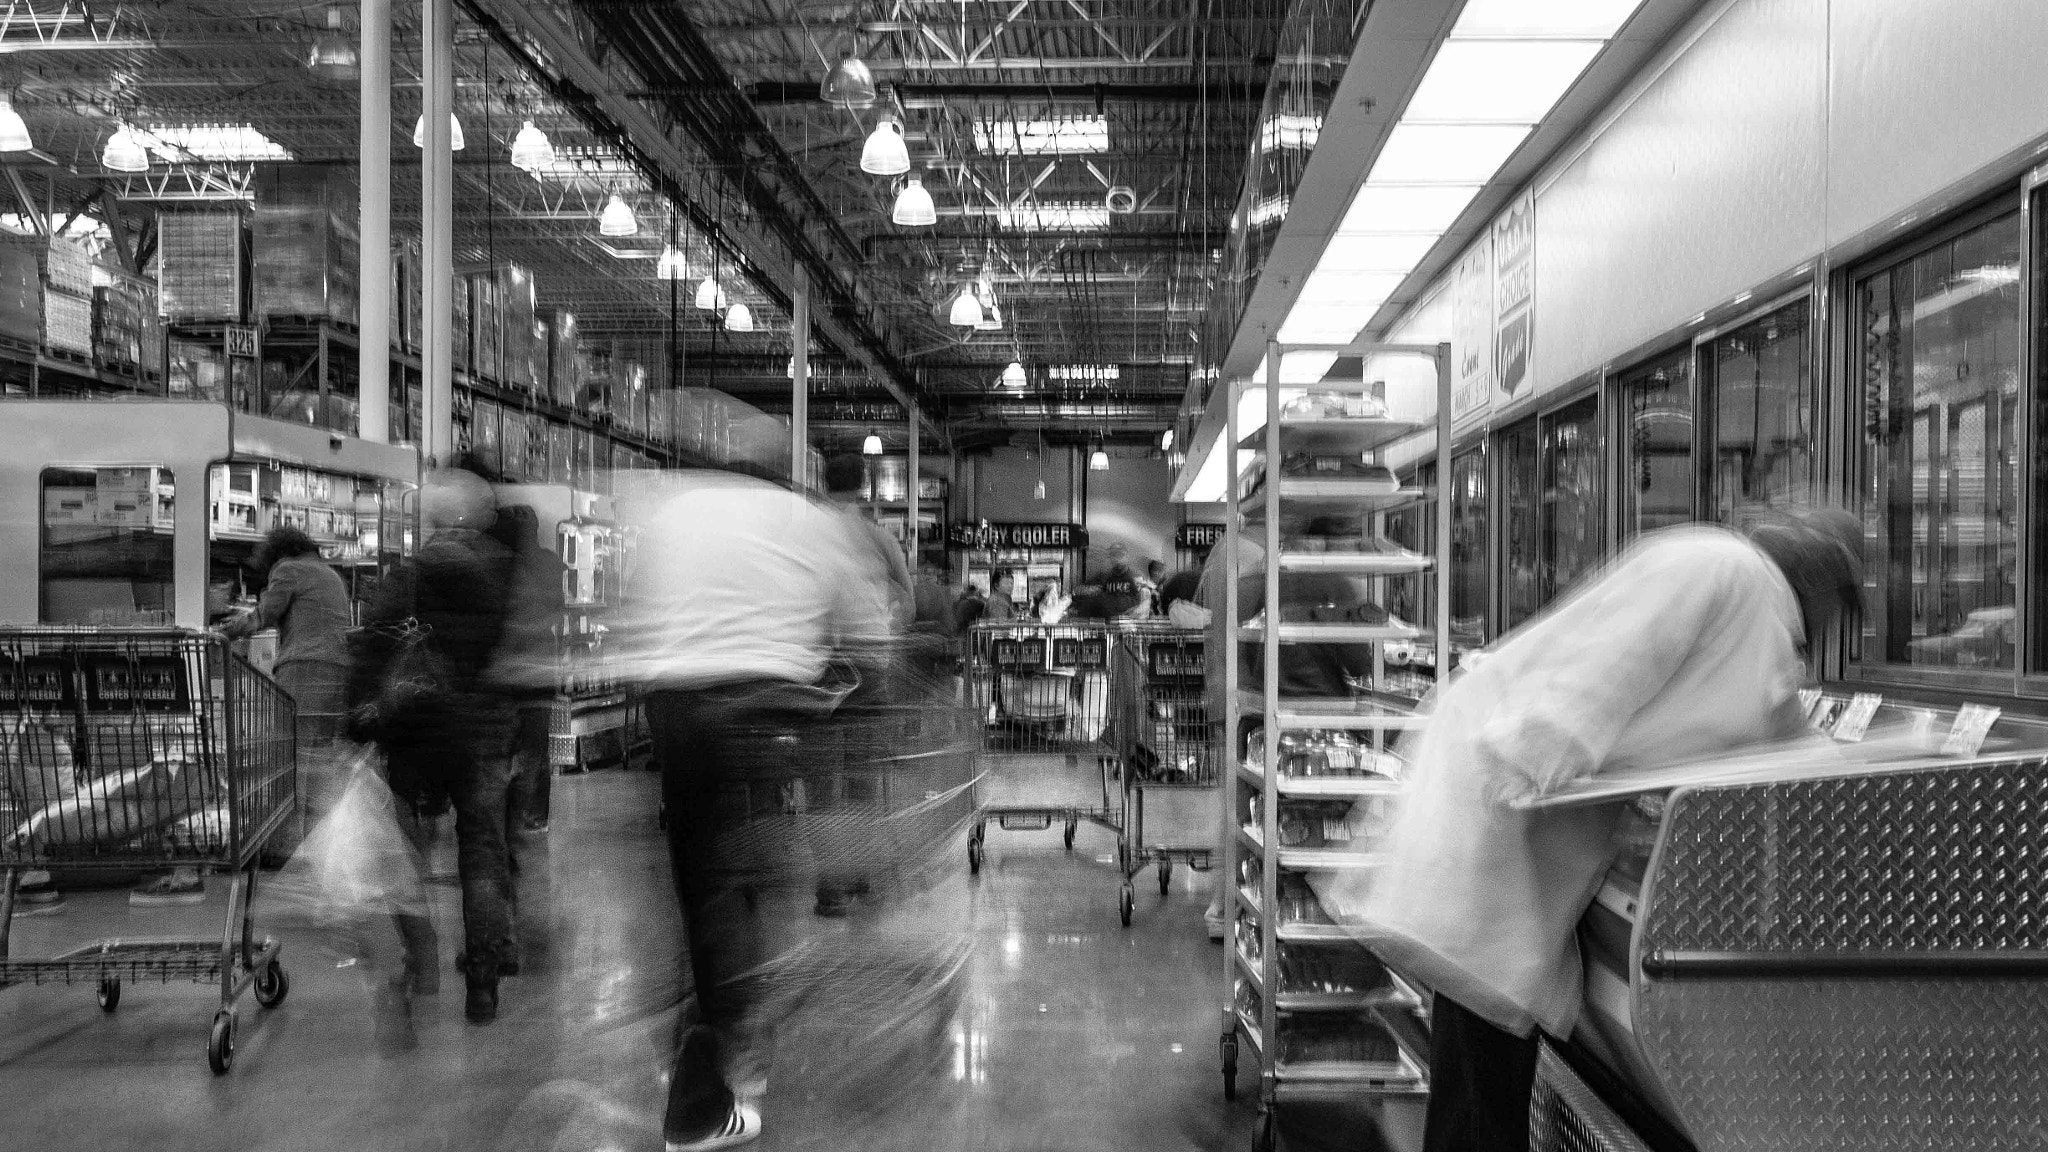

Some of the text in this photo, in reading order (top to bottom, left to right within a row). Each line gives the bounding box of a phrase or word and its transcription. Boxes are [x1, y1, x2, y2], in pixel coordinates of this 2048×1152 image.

[1500, 261, 1529, 311] CHOICE
[1012, 525, 1069, 545] COOLER
[1186, 526, 1226, 545] FRES
